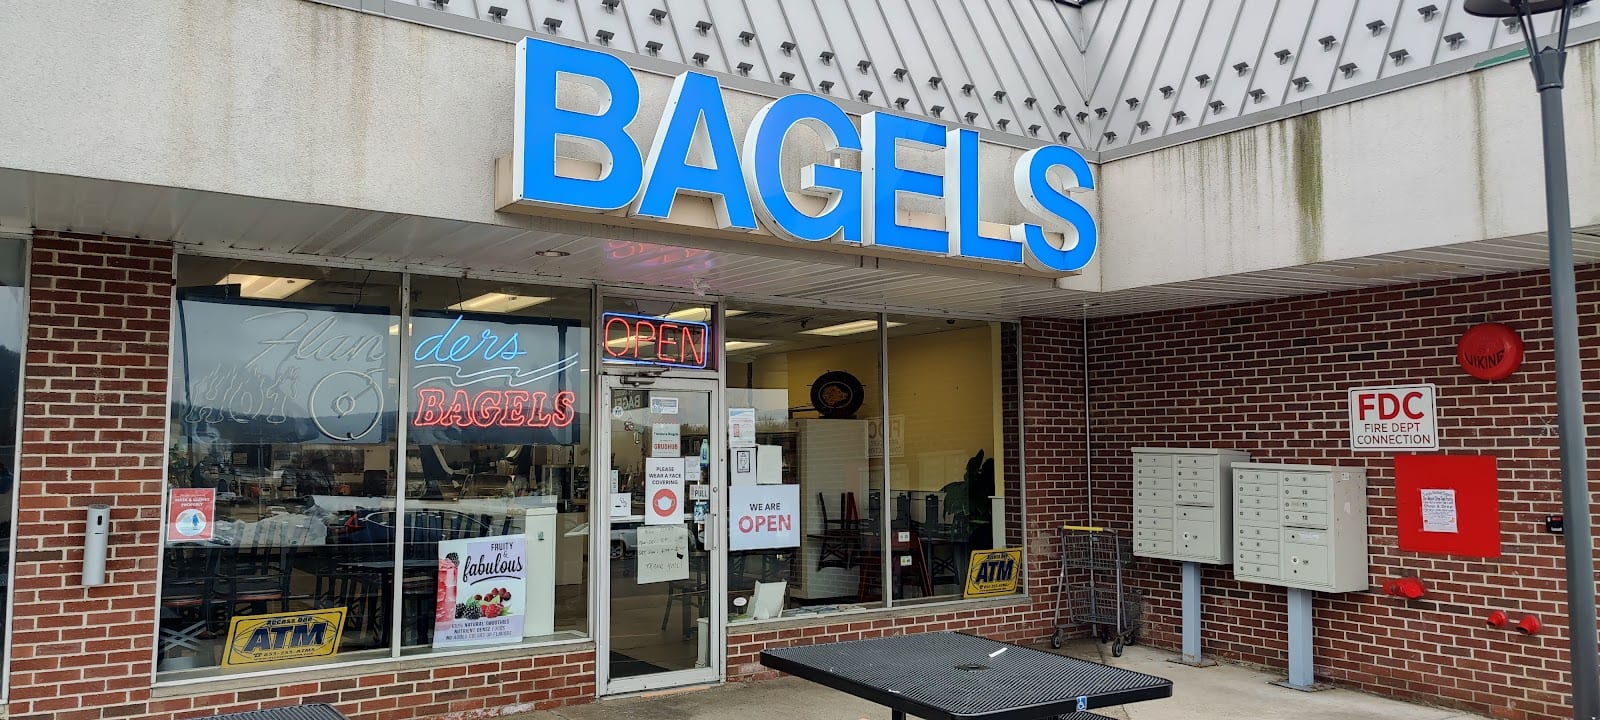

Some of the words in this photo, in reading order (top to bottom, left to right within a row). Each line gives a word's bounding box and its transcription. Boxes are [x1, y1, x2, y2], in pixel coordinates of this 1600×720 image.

[514, 37, 1098, 273] BAGELS
[604, 317, 705, 365] OPEN
[1464, 348, 1505, 369] VIKING
[413, 388, 577, 428] BAGELS
[1358, 391, 1425, 421] FDC
[1364, 423, 1388, 433] FIRE
[1391, 422, 1421, 433] DEPT
[1357, 434, 1431, 445] CONNECTION
[749, 503, 763, 511] WE
[764, 503, 781, 511] ARE
[738, 514, 792, 534] OPEN
[491, 542, 514, 551] FRUITY
[462, 553, 523, 583] fabulous
[975, 559, 1014, 582] ATM
[241, 621, 329, 653] ATM
